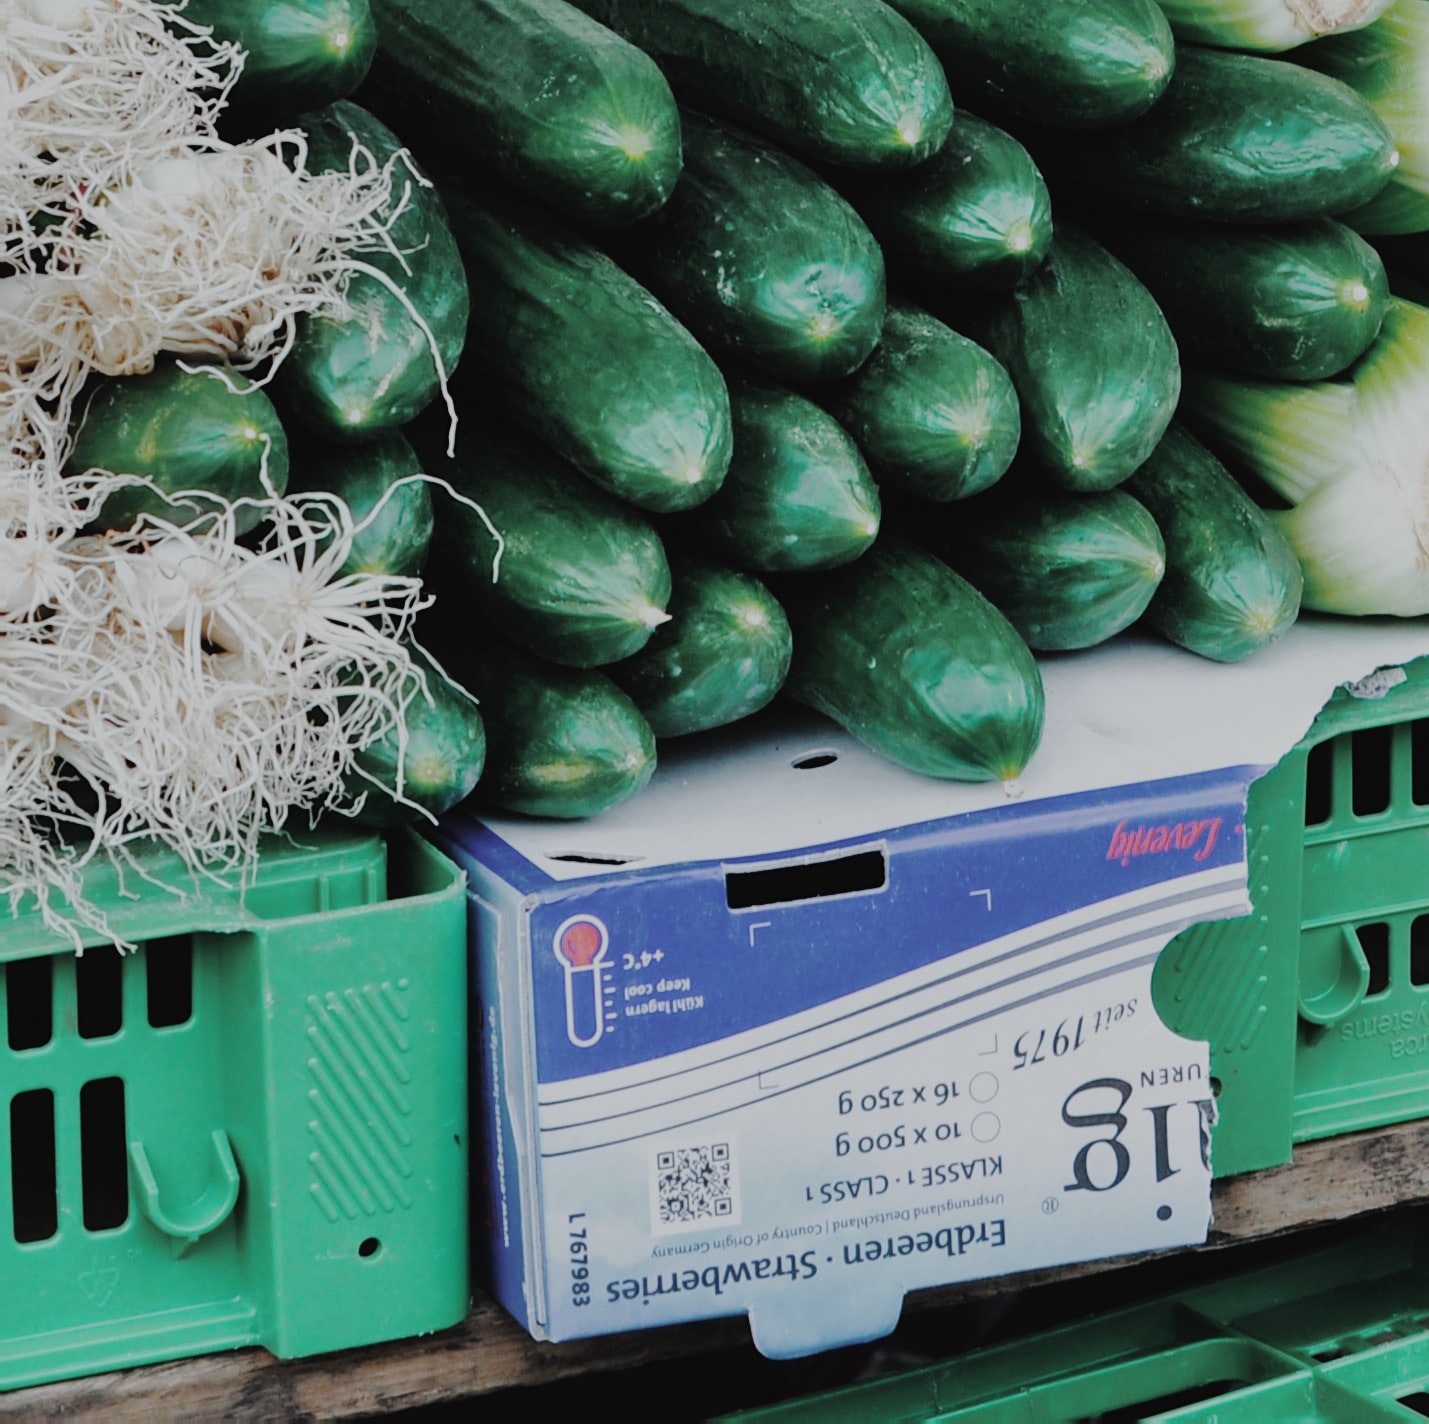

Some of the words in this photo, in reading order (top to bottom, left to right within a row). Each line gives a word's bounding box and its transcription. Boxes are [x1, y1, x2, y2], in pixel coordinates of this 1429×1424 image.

[624, 984, 653, 1001] cool
[656, 978, 691, 993] Keep
[625, 998, 671, 1017] lagern
[672, 995, 705, 1014] Kühl
[1093, 998, 1138, 1034] seit
[1013, 1016, 1086, 1071] 1975
[838, 1090, 854, 1116] g
[860, 1085, 905, 1112] 250
[933, 1081, 961, 1107] 16
[836, 1131, 851, 1157] g
[857, 1125, 906, 1154] 500
[934, 1122, 962, 1141] 10
[921, 1155, 1003, 1187] KLASSE
[819, 1175, 889, 1204] CLASS
[913, 1192, 1006, 1221] Ursprungsland
[772, 1221, 823, 1244] Country
[832, 1209, 911, 1233] Deutschland
[650, 1239, 711, 1259] Germany
[713, 1233, 754, 1251] Origin
[756, 1232, 770, 1245] of
[842, 1218, 1007, 1268] Erdbeeren
[568, 1227, 591, 1308] 767983
[606, 1250, 818, 1306] Strawberries
